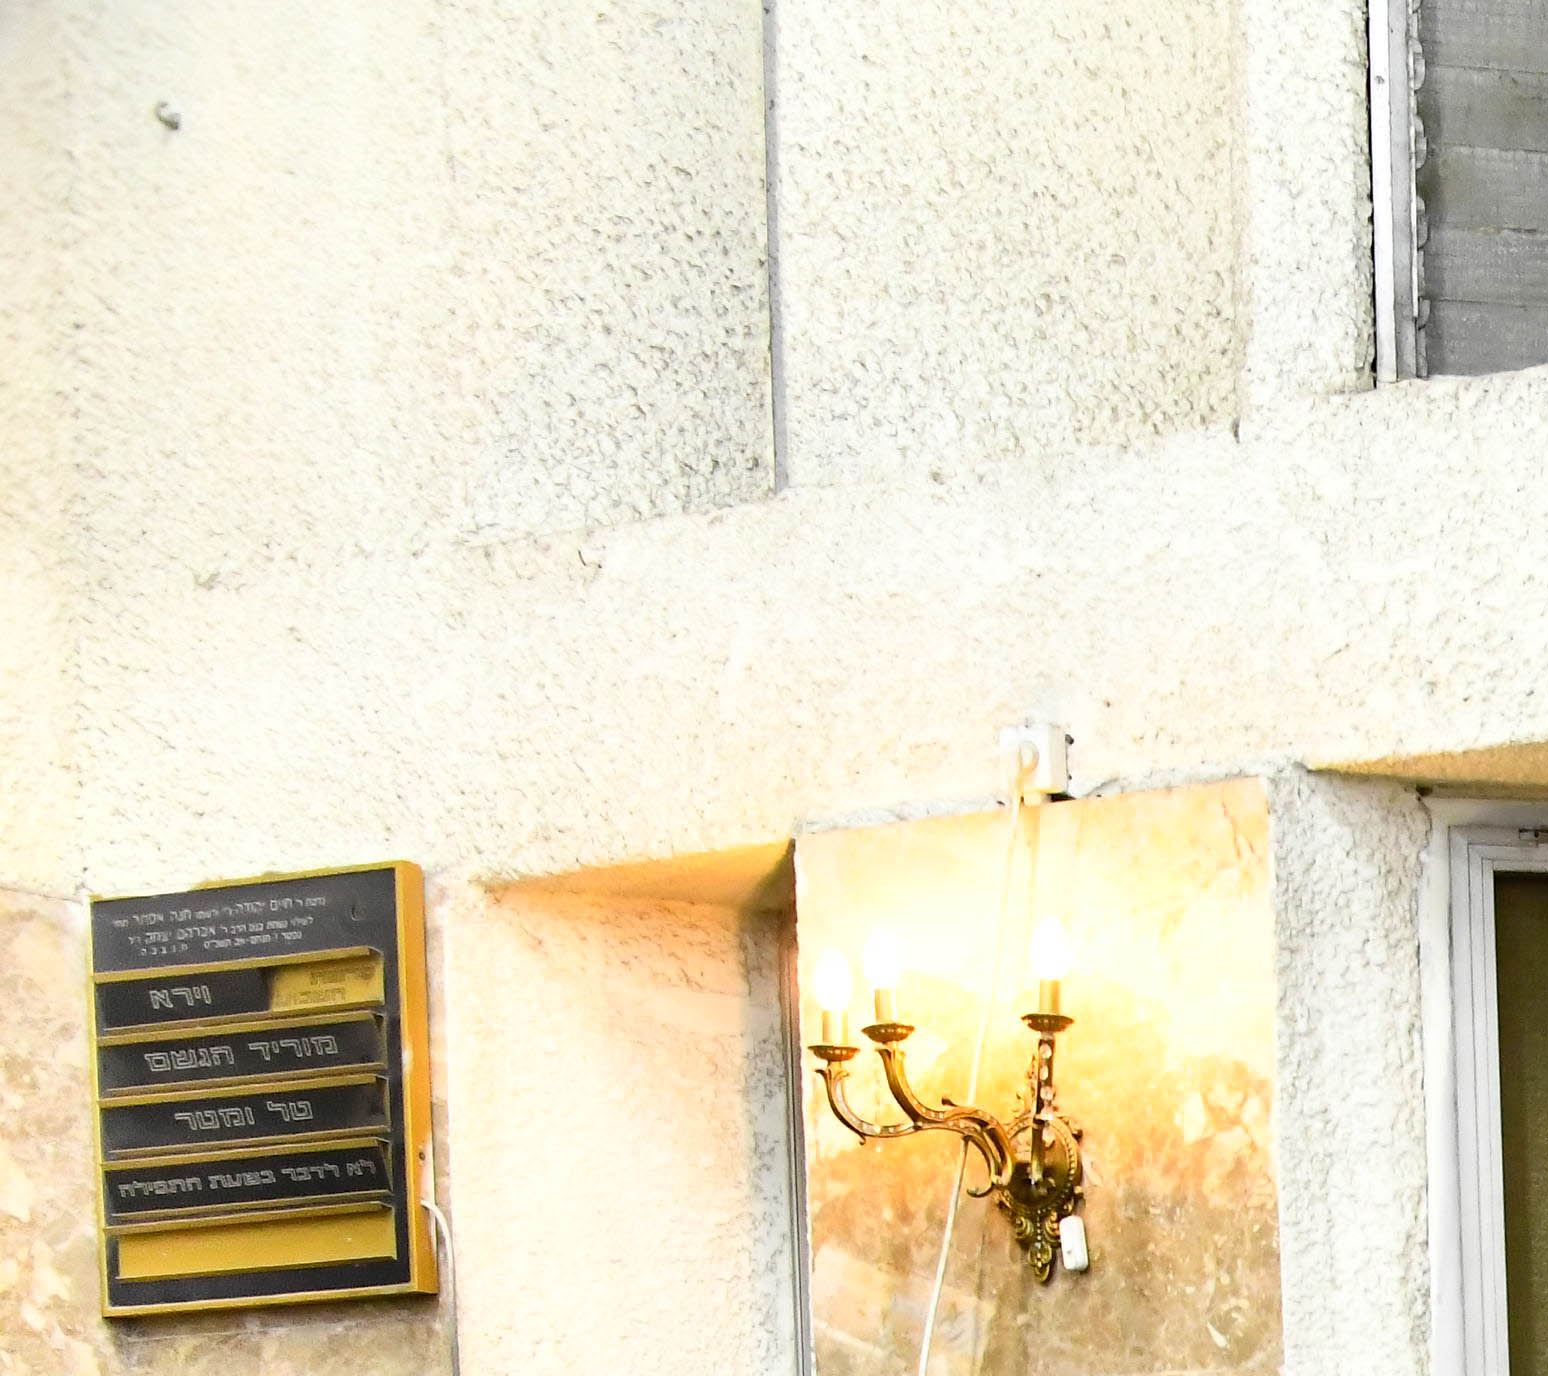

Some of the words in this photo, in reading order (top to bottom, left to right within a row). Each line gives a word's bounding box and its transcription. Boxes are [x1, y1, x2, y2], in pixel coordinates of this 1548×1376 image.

[148, 984, 213, 1010] וירא
[143, 1045, 235, 1072] הגשם
[248, 1034, 339, 1061] מוריד
[174, 1106, 256, 1131] ומטר
[266, 1100, 314, 1122] טל
[208, 1169, 276, 1190] בשעת
[281, 1162, 340, 1182] לדבר
[117, 1177, 203, 1198] התפילה
